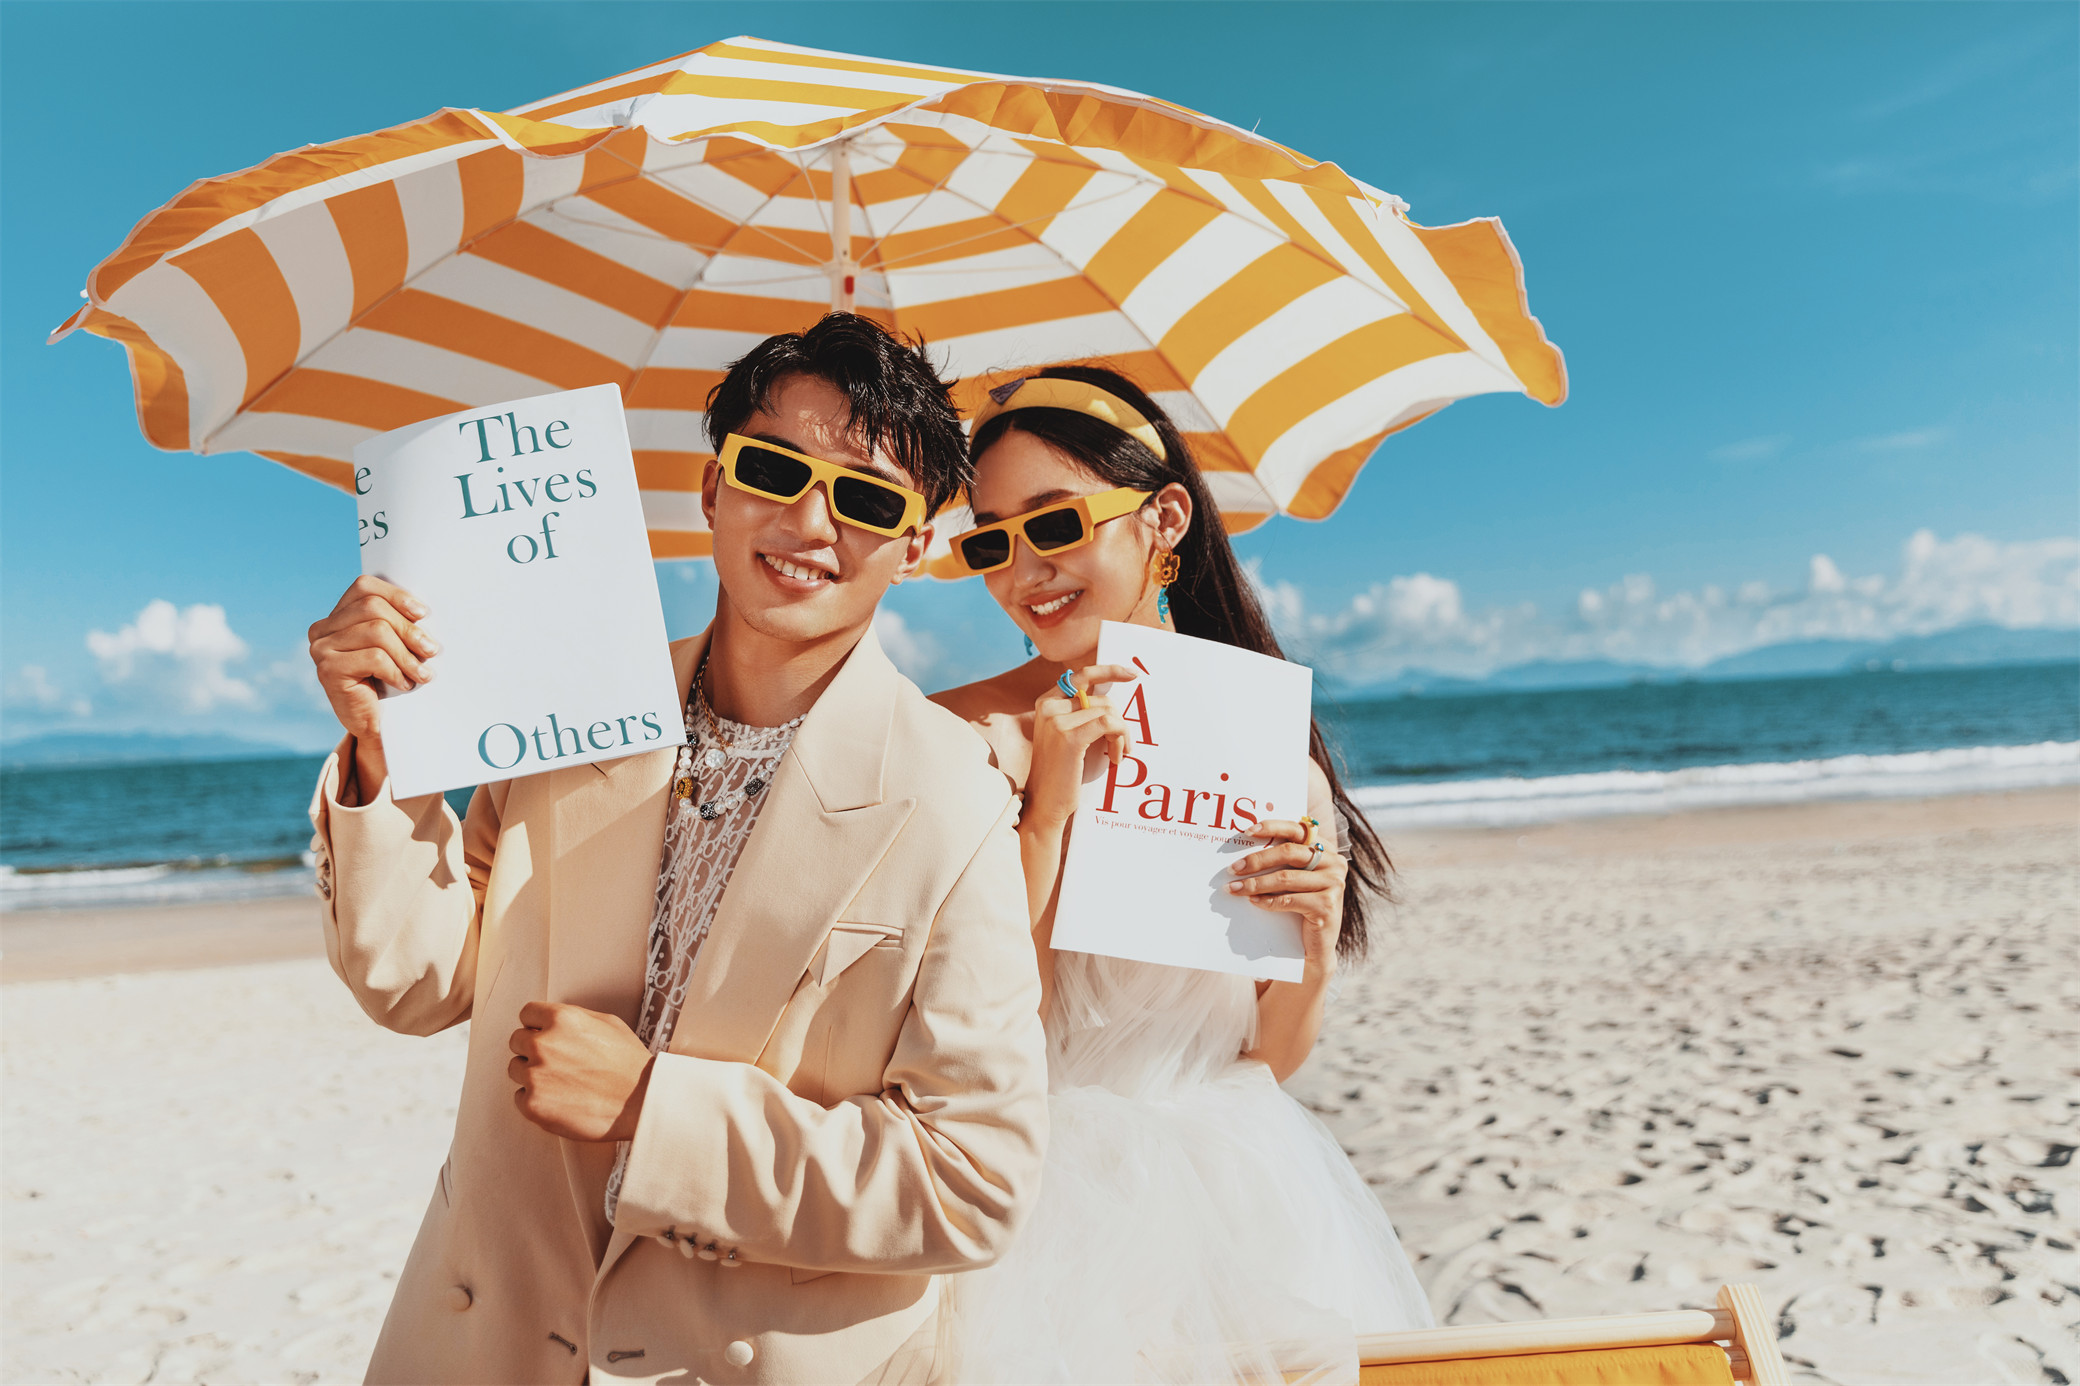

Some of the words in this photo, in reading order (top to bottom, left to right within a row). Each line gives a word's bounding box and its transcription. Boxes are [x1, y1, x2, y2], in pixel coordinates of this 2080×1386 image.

[458, 411, 573, 464] The
[453, 466, 598, 519] Lives
[506, 511, 560, 564] of
[477, 710, 663, 769] Others
[1111, 820, 1132, 830] pour
[1210, 834, 1233, 844] pour
[1232, 836, 1255, 847] vivre
